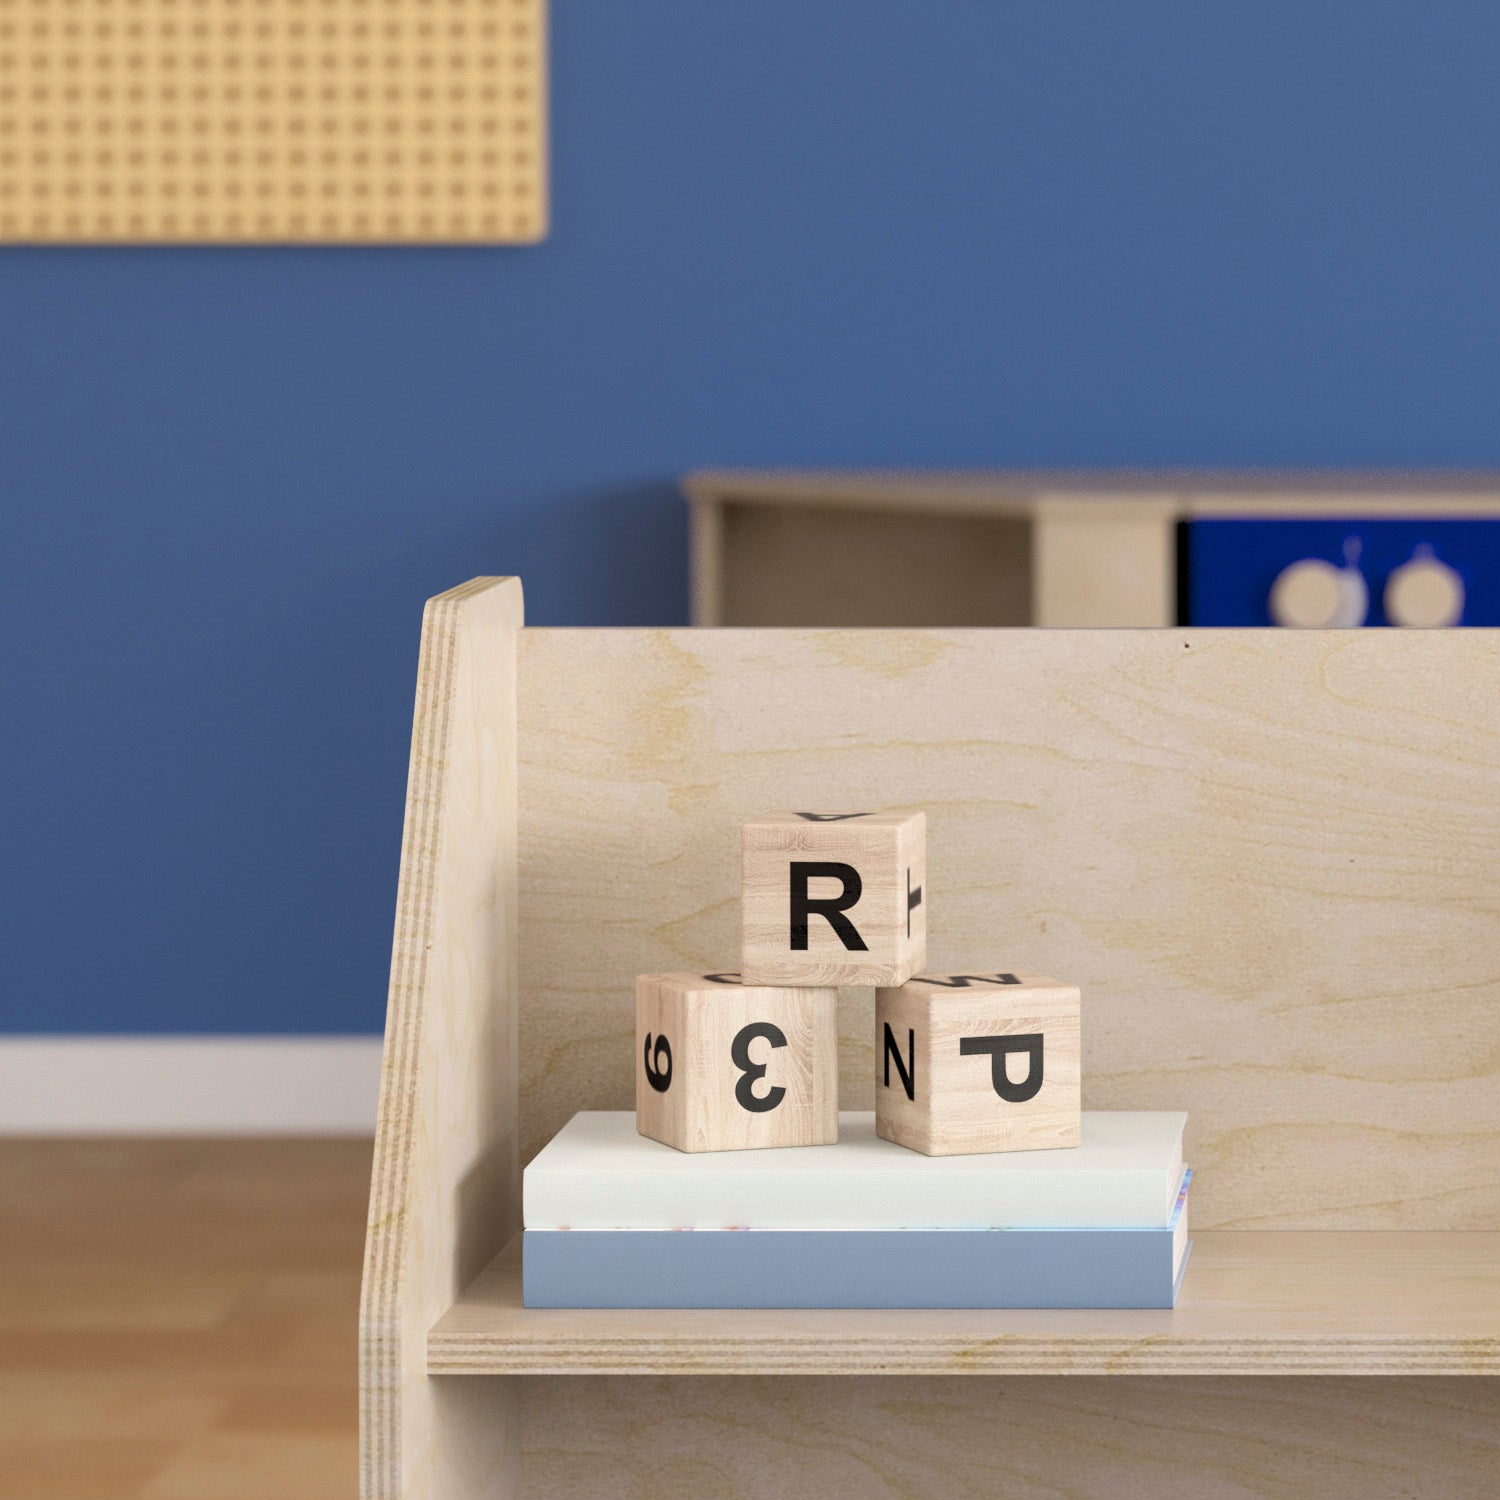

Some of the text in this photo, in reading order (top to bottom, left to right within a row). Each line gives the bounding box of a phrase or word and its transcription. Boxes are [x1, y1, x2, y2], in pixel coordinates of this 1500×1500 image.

[789, 861, 870, 952] R
[883, 1022, 915, 1102] N
[959, 1032, 1044, 1103] P
